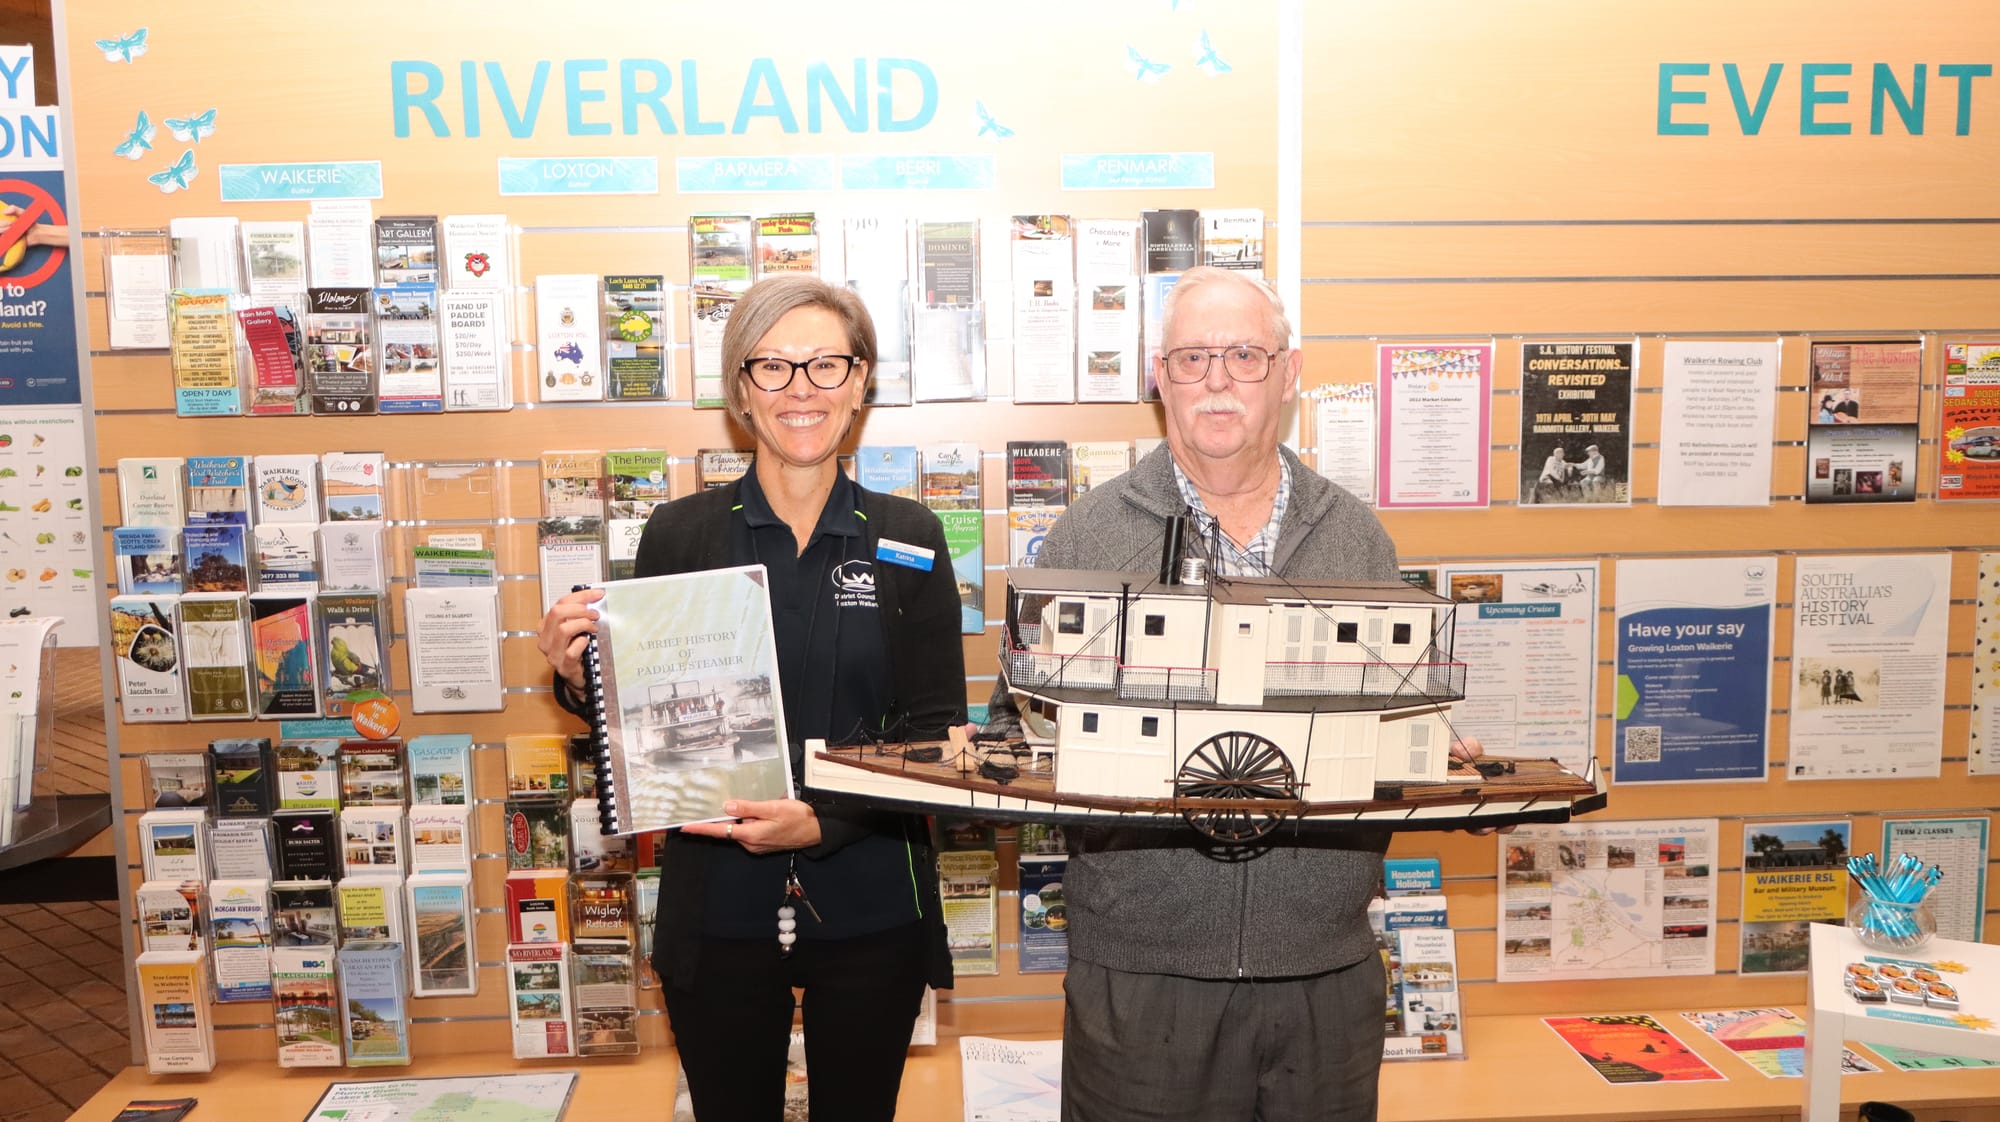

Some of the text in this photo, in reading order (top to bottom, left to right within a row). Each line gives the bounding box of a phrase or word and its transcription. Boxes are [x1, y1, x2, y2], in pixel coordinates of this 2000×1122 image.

[391, 58, 939, 138] RIVERLAND
[1657, 63, 1992, 136] EVENT
[543, 163, 613, 179] LOXTON
[714, 162, 797, 177] BARMERA
[895, 160, 941, 176] BERRI
[1098, 159, 1178, 175] RENMARK
[261, 169, 342, 185] WAIKERIE
[396, 229, 432, 238] GALLERY
[1089, 227, 1131, 237] Chocolates
[1103, 239, 1121, 247] More
[7, 283, 25, 297] to
[450, 311, 486, 319] PADDLE
[1539, 344, 1616, 355] S.A. HISTORY FESTIVAL
[1529, 359, 1630, 370] CONVERSATIONS...
[1684, 356, 1763, 366] Waikerie Rowing Club
[1548, 374, 1606, 386] REVISITED
[182, 389, 232, 398] OPEN 7 DAYS
[1558, 389, 1596, 400] EXHIBITION
[1553, 413, 1573, 423] APRIL
[1600, 412, 1617, 423] MAY
[1013, 448, 1061, 457] WILKADENE
[613, 455, 662, 465] The Pines
[262, 468, 301, 477] WAIKERIE
[943, 514, 978, 524] Cruise
[415, 550, 460, 558] WAIKERIE
[1801, 573, 1854, 587] SOUTH
[834, 592, 856, 600] Dstrict
[1801, 585, 1893, 600] AUSTRALIA'S
[327, 606, 345, 614] Walk
[352, 605, 370, 613] Drive
[1484, 604, 1556, 617] Upcoming Cruises
[1801, 599, 1868, 613] HISTORY
[1800, 612, 1874, 626] FESTIVAL
[1628, 623, 1745, 639] Have your say
[637, 631, 738, 651] A BRIEF HISTORY
[678, 648, 694, 658] OF
[1628, 642, 1733, 655] Growing Loxton Waikerie
[637, 655, 744, 677] PADDLE STEAMER
[129, 687, 152, 695] Jacobs
[372, 700, 388, 714] Here
[372, 711, 380, 720] in
[355, 711, 388, 735] Waikerie
[1391, 870, 1435, 880] Houseboat
[1757, 873, 1836, 885] WAIKERIE RSL
[1396, 879, 1432, 890] Holidays
[214, 905, 236, 913] MORGAN
[585, 904, 622, 919] Wigley
[585, 918, 624, 929] Retreat
[303, 960, 325, 969] BIG4
[1406, 1047, 1422, 1056] Hire
